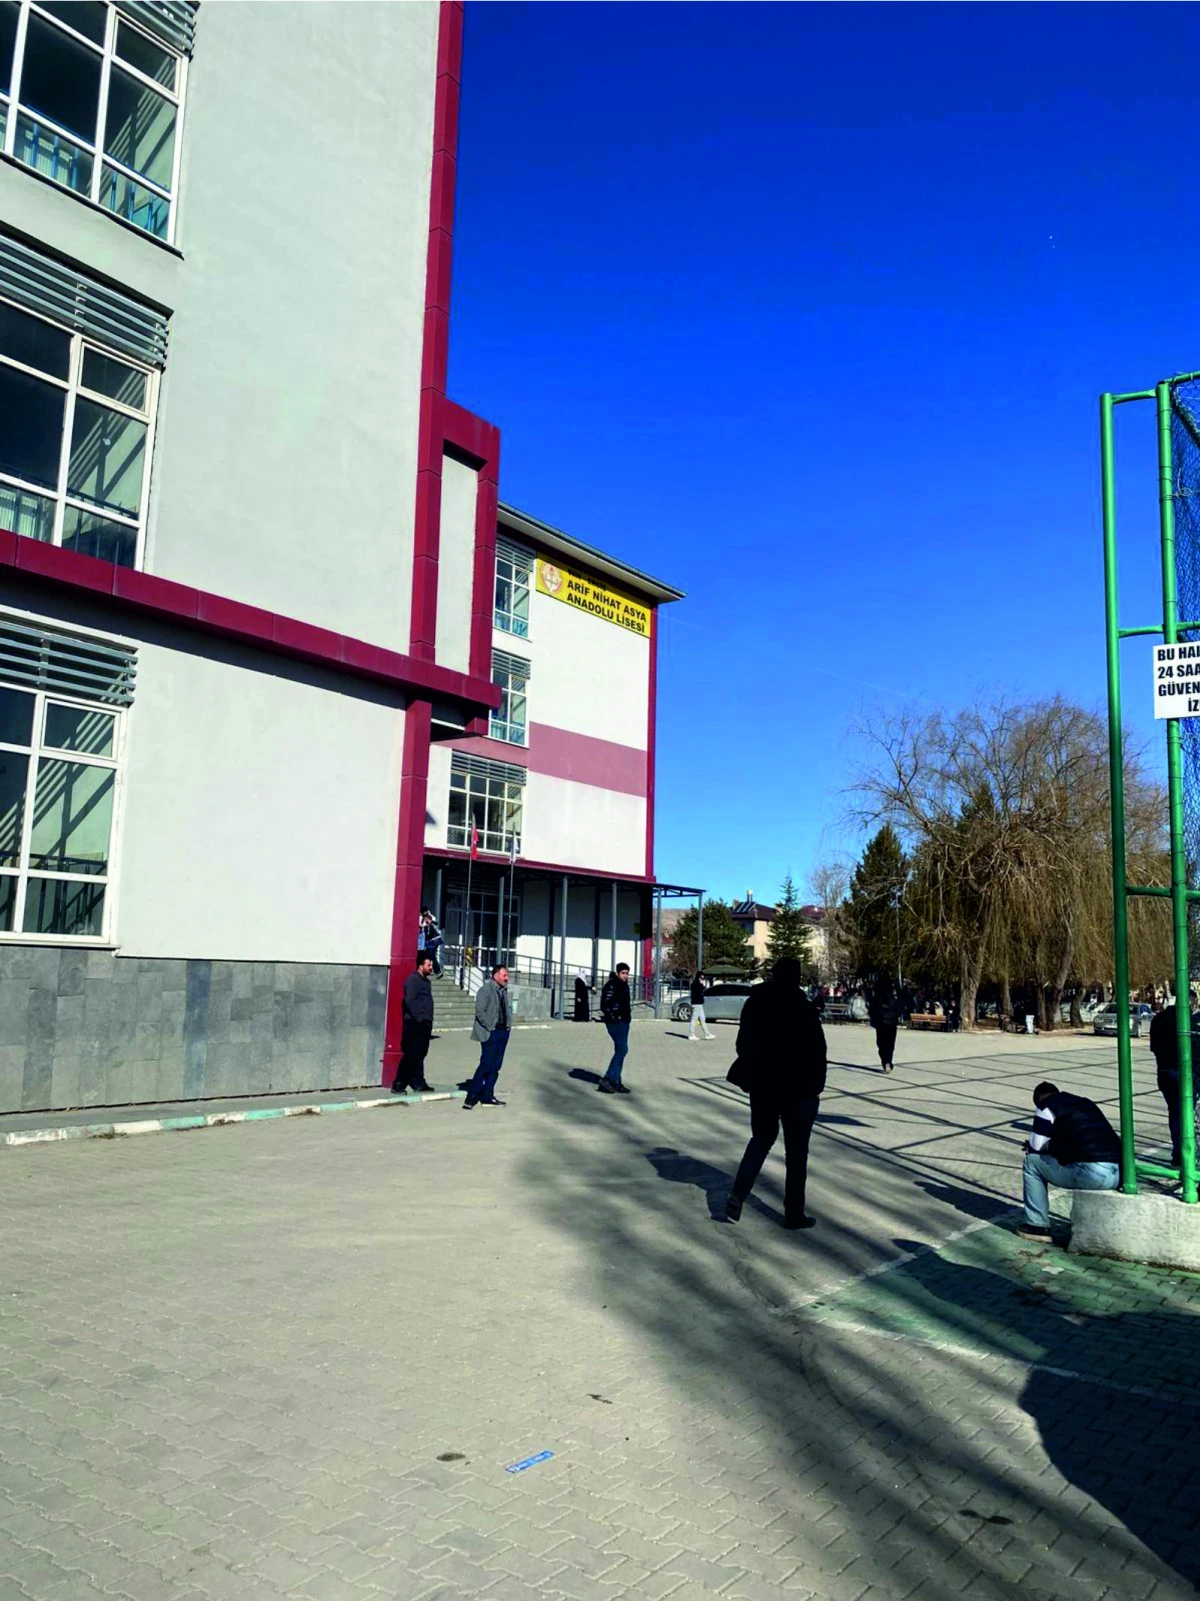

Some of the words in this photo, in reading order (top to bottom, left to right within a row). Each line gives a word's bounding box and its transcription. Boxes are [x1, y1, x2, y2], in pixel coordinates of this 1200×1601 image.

[567, 579, 590, 595] ARİF
[593, 589, 621, 610] NİHAT
[623, 605, 647, 622] ASYA
[566, 593, 614, 619] ANADOLU
[616, 614, 645, 633] LİSESİ
[1157, 648, 1175, 661] BU
[1157, 666, 1174, 679] 24
[1158, 681, 1200, 697] GÜVEN
[1188, 697, 1200, 712] İZ
